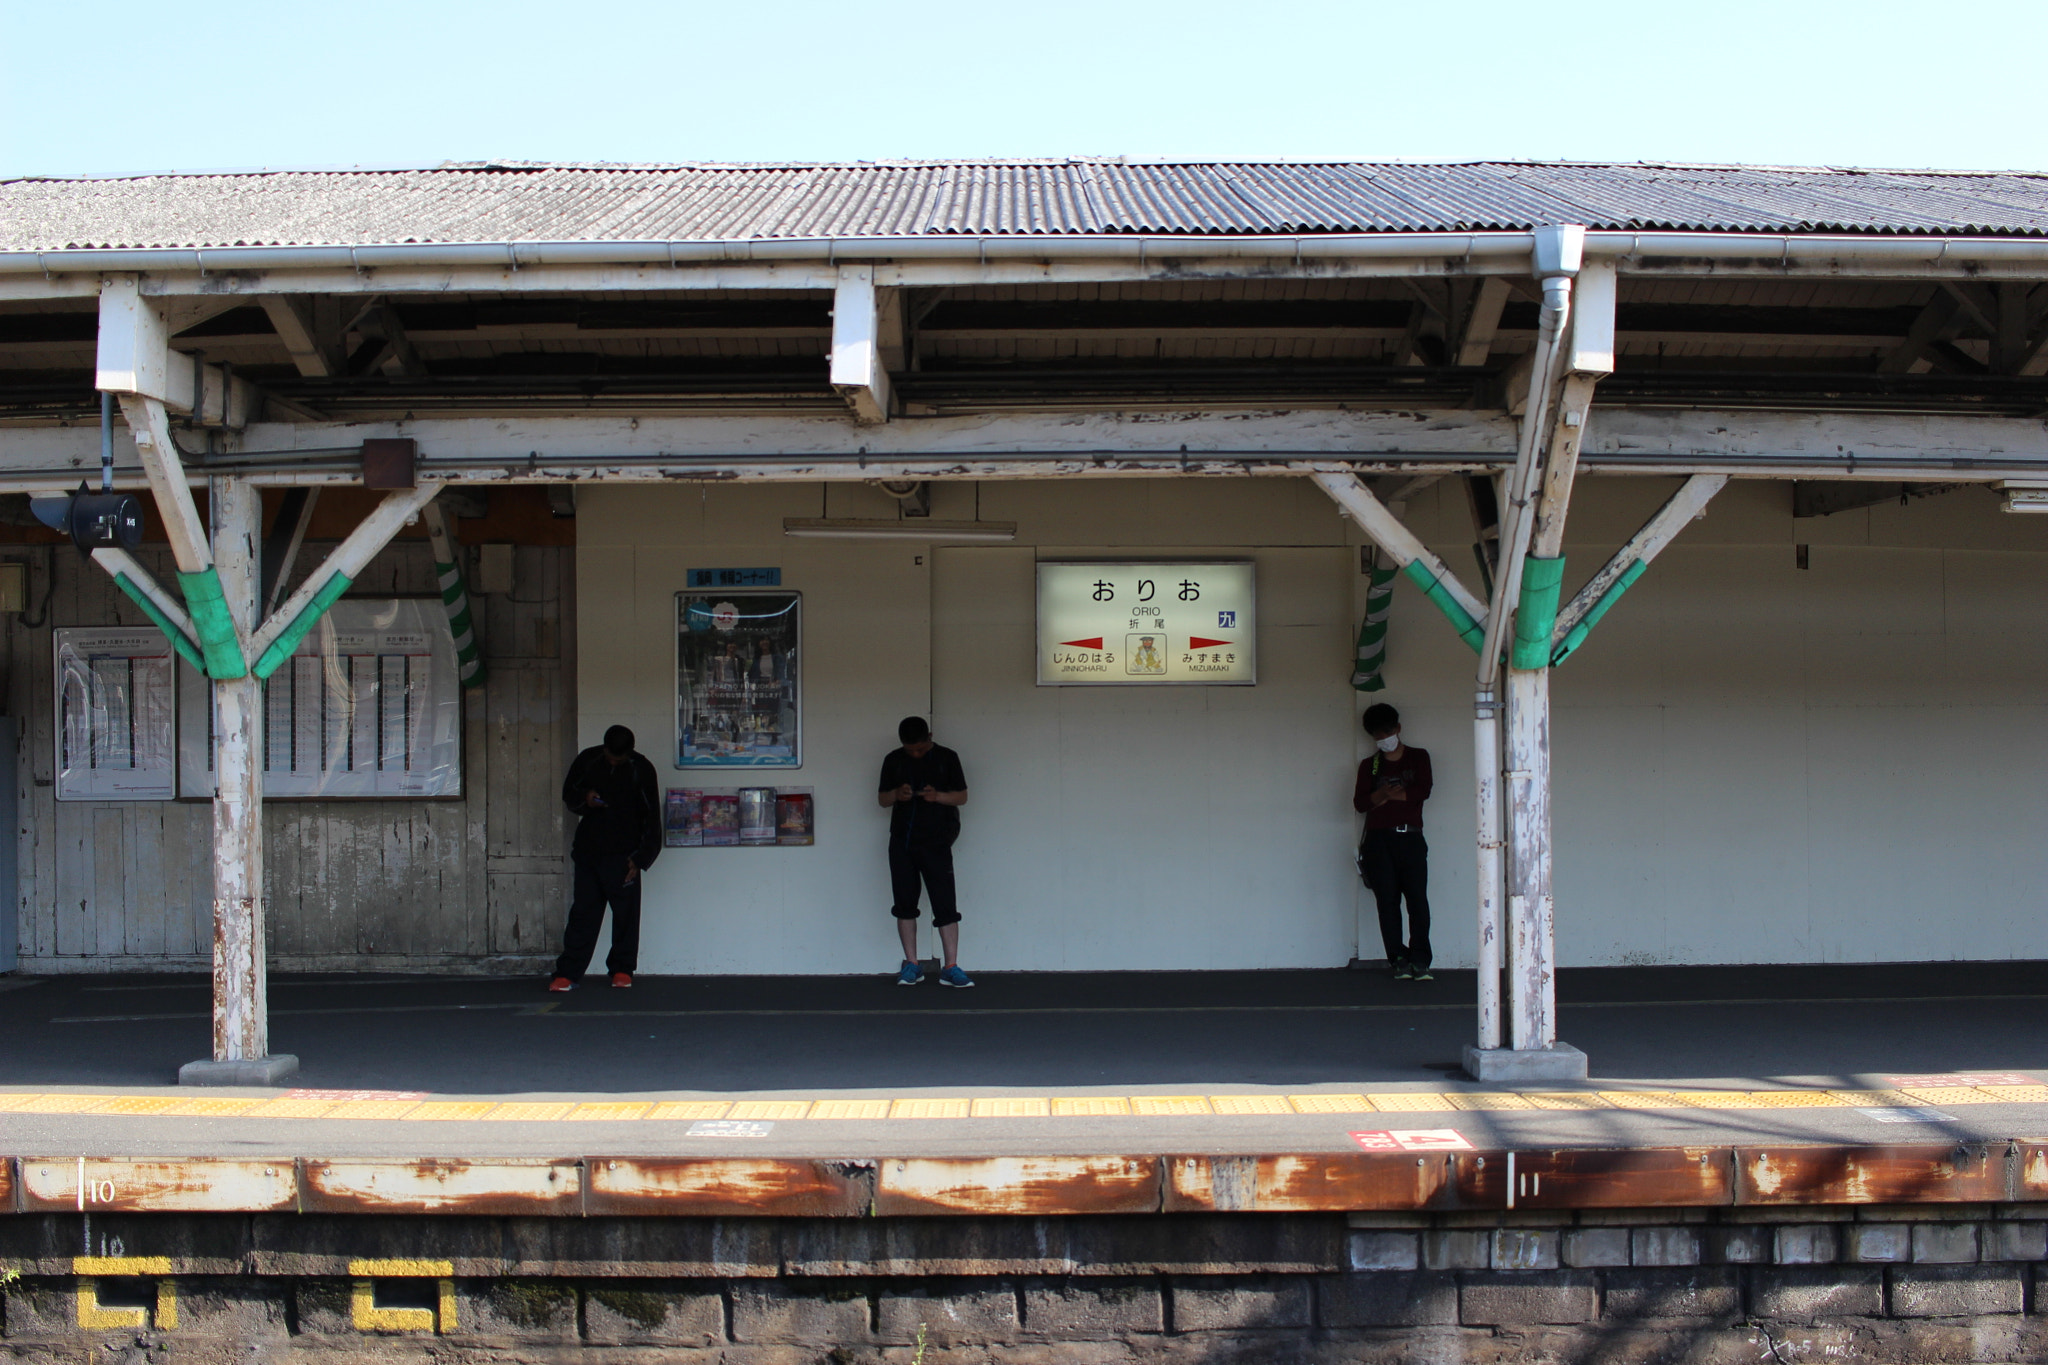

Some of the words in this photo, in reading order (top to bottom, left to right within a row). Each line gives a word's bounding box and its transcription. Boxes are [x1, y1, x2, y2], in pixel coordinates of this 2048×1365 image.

[1092, 579, 1200, 602] おりお
[1132, 606, 1161, 617] ORIO
[1129, 618, 1165, 630] 折尾
[1219, 612, 1235, 627] 九
[1053, 653, 1115, 664] じんのはる
[1182, 653, 1236, 664] みずまき
[1061, 665, 1108, 673] JINNOHARU
[1188, 664, 1230, 673] MIZUMAKI
[1355, 1133, 1397, 1149] 783
[1402, 1135, 1457, 1145] 4
[1520, 1172, 1540, 1197] 11
[91, 1179, 115, 1203] 10
